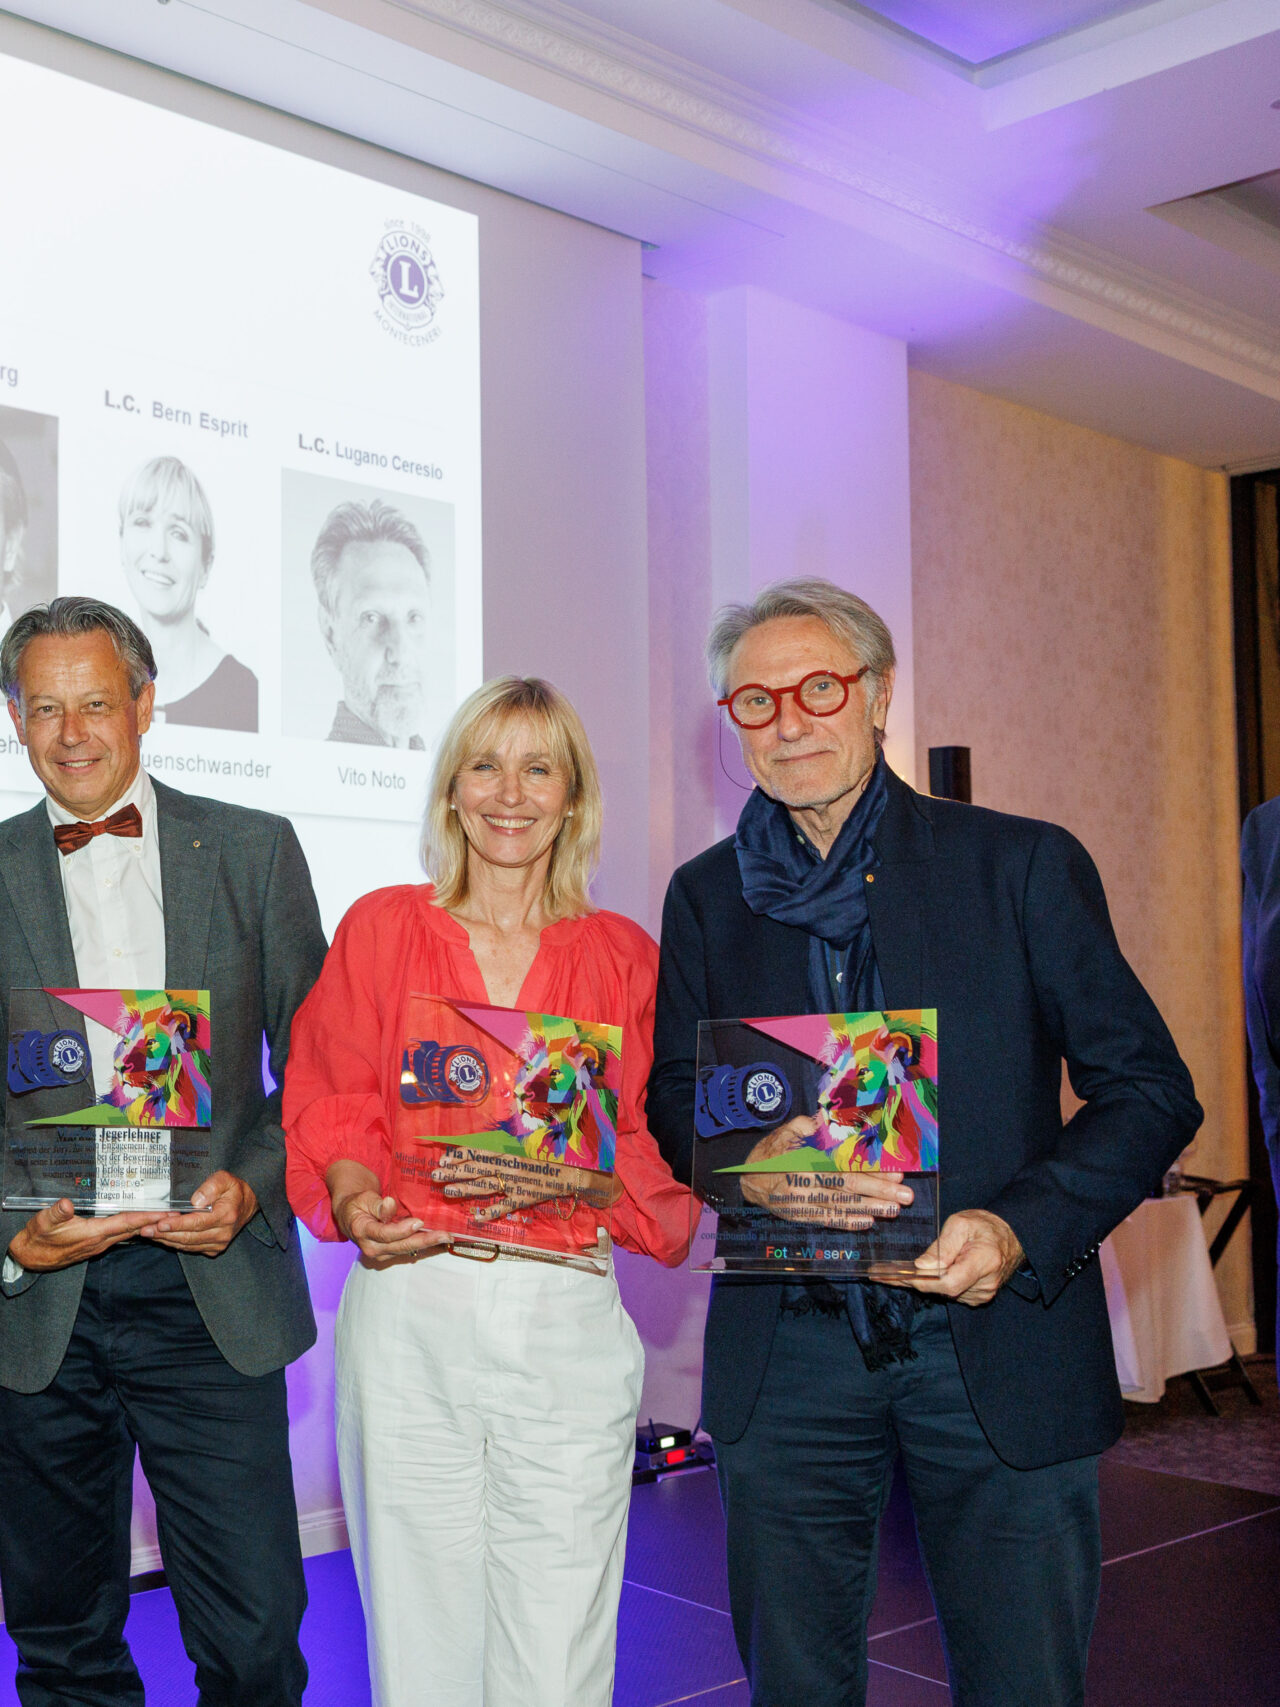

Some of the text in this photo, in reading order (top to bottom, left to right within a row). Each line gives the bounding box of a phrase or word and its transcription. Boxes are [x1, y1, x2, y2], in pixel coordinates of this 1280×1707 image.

[385, 235, 429, 262] LIONS
[399, 260, 419, 299] L
[104, 389, 249, 439] L.C. Bern Esprit
[298, 433, 443, 481] L.C. Lugano Ceresio
[141, 751, 272, 779] uenschwander
[337, 766, 407, 790] Vito Noto
[57, 1040, 78, 1050] LIONS
[454, 1055, 476, 1066] LIONS
[751, 1074, 773, 1085] LIONS
[761, 1086, 773, 1100] L
[99, 1127, 161, 1140] Jegerlehner
[445, 1145, 561, 1177] Pia Neuenschwander
[494, 1169, 543, 1187] Engagement,
[785, 1174, 845, 1187] Vito Noto
